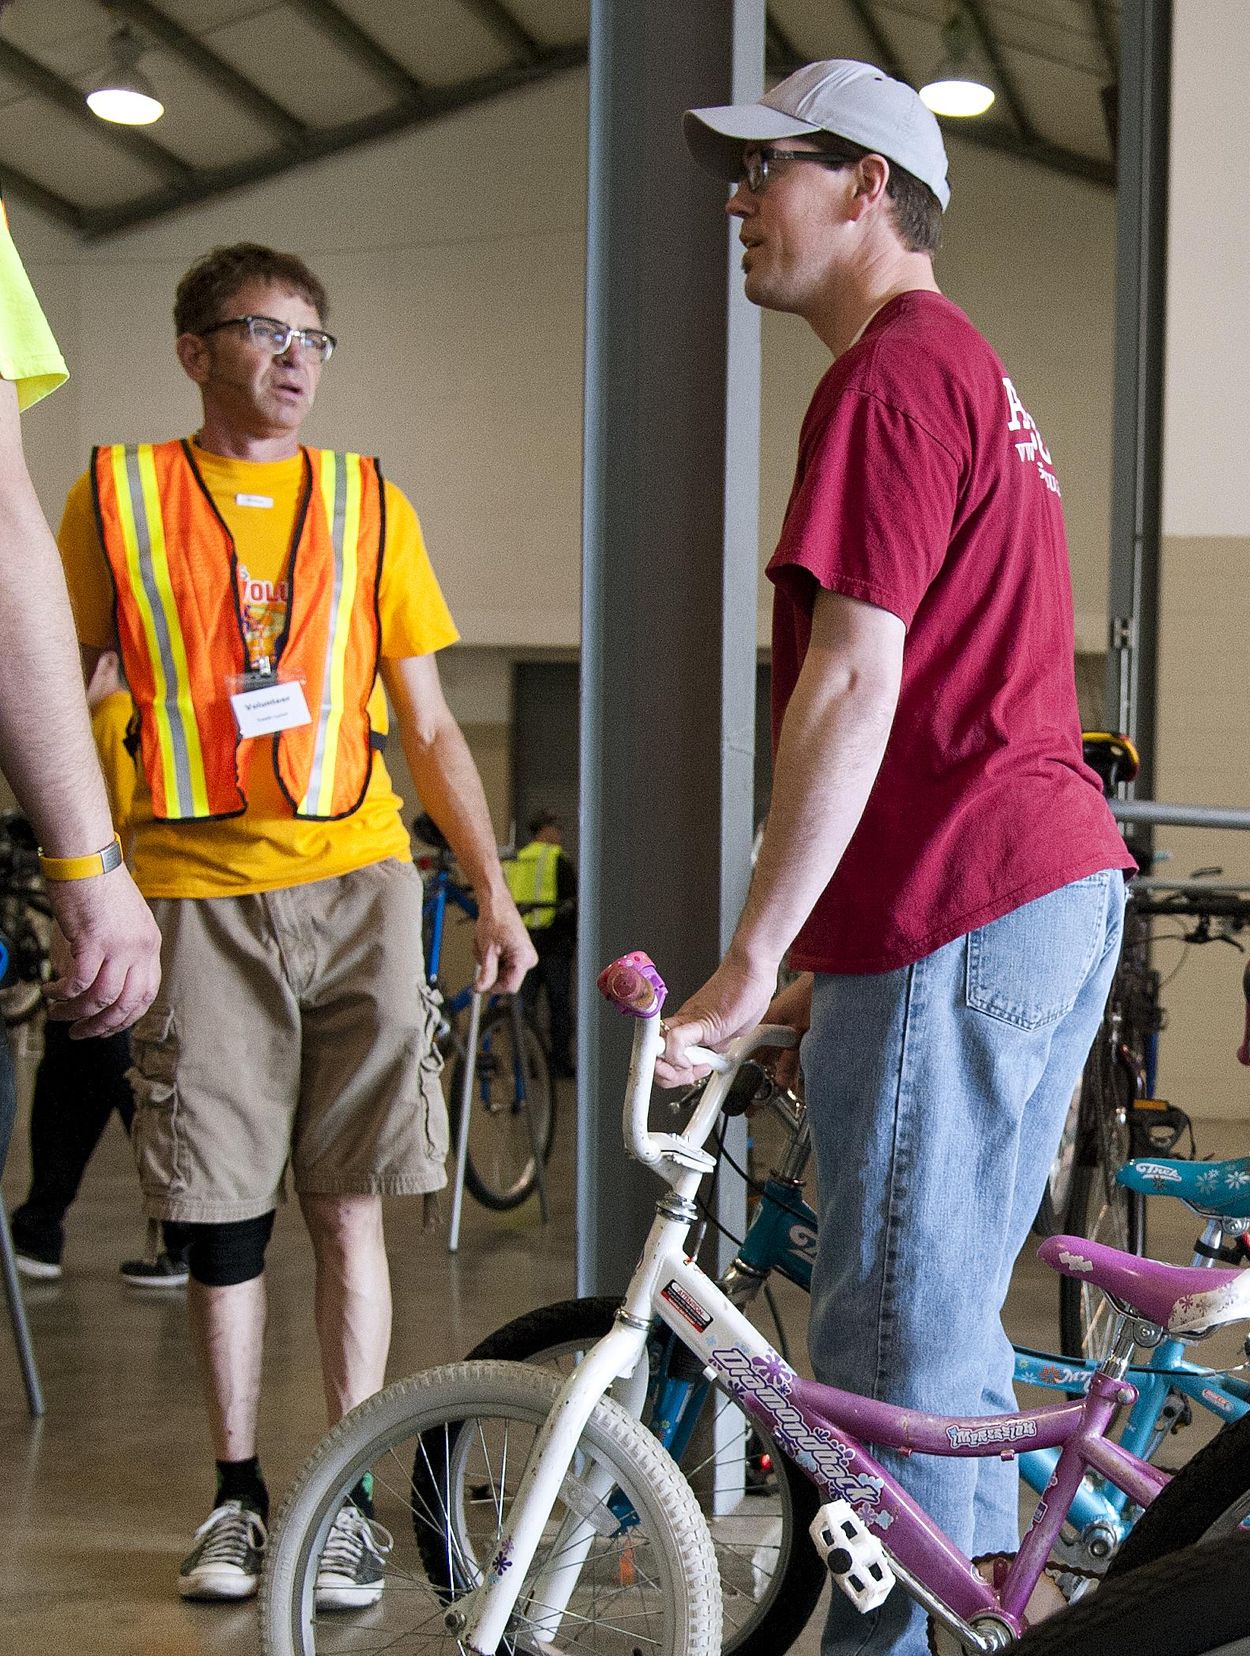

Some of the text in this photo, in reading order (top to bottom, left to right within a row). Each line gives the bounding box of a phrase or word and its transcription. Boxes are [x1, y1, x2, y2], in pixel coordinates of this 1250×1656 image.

[245, 697, 291, 711] Volunteer
[1135, 1163, 1182, 1181] Trek
[678, 1288, 705, 1317] ATTENTION
[711, 1347, 881, 1503] Diamondback
